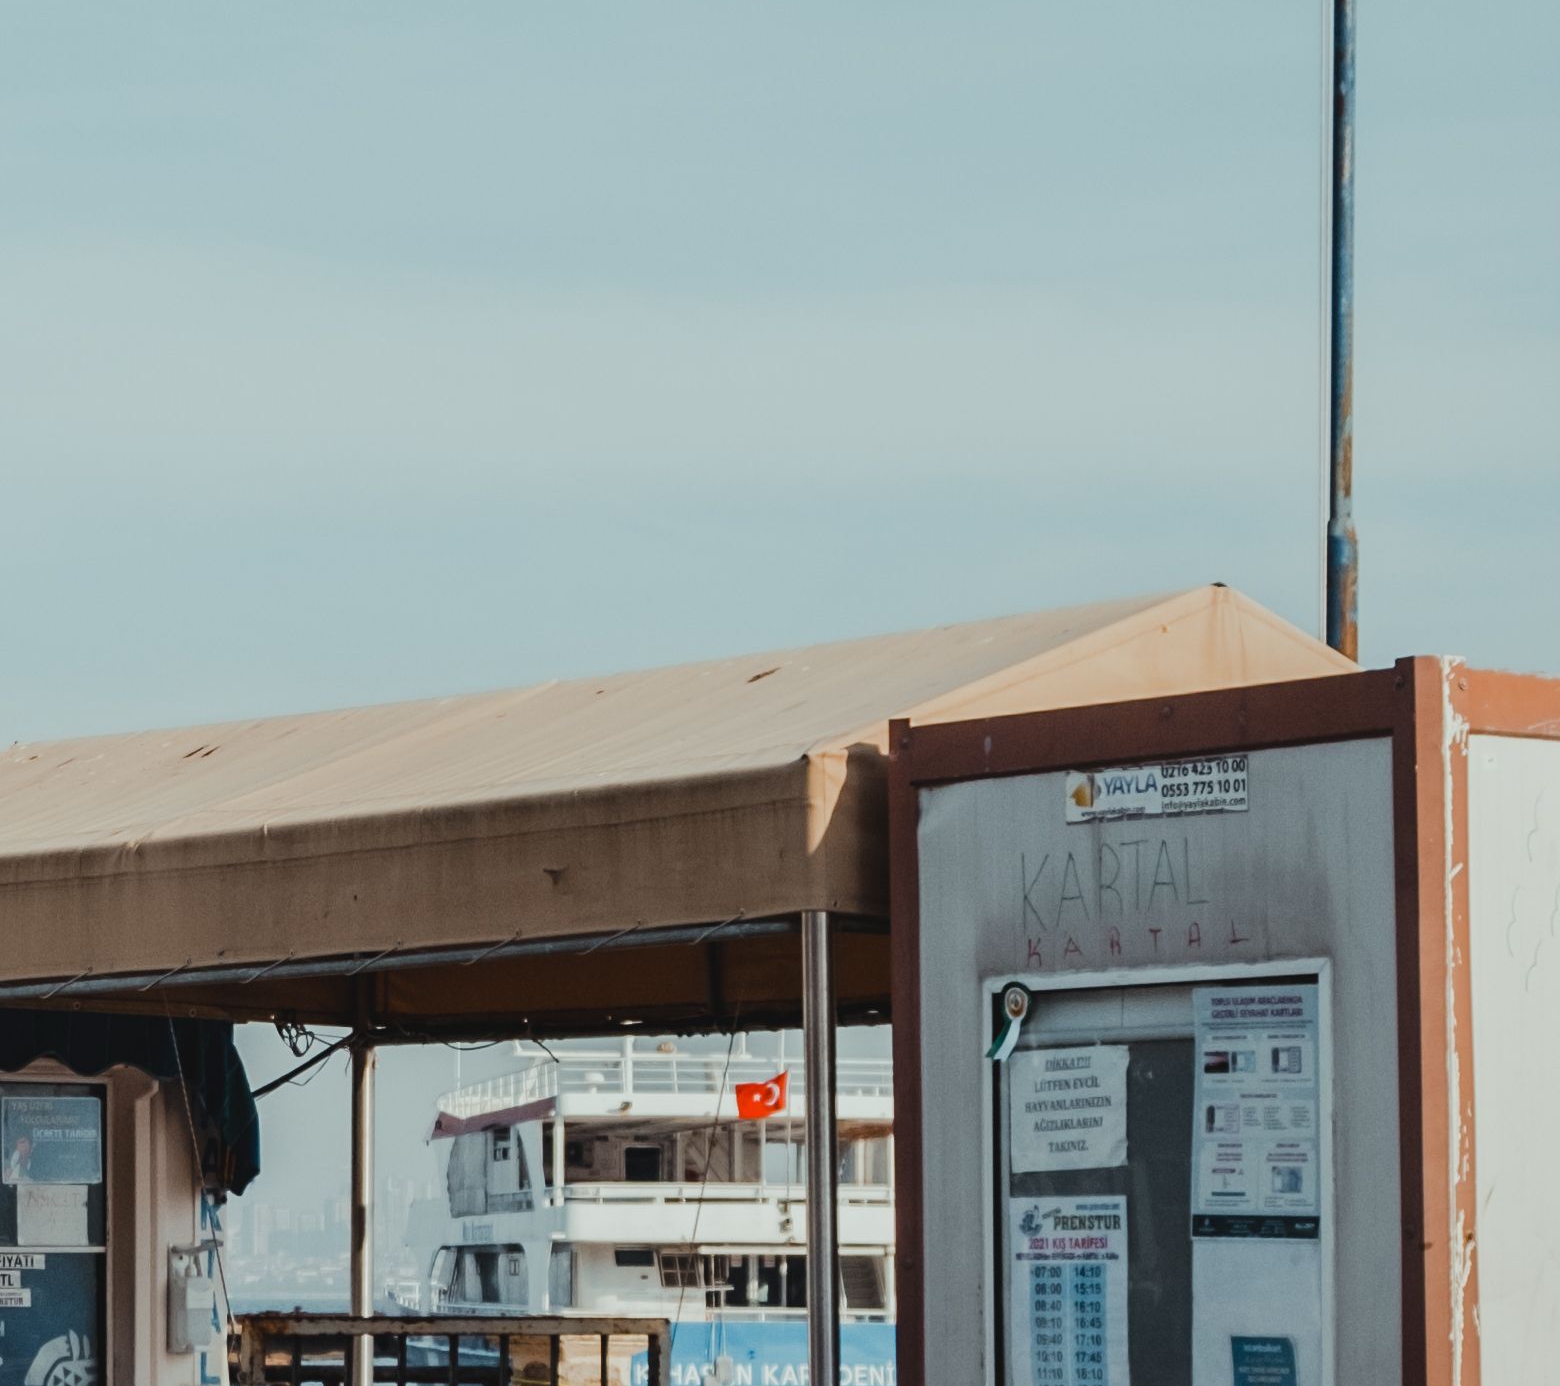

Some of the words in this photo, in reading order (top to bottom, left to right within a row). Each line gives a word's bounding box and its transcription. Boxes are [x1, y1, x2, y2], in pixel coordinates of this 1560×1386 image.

[1103, 773, 1157, 797] YAYLA
[1216, 760, 1230, 774] 10
[1231, 759, 1246, 772] 00
[1161, 782, 1189, 797] 0553
[1192, 781, 1214, 795] 775
[1218, 779, 1230, 794] 10
[1233, 778, 1246, 792] 01
[1021, 837, 1209, 937] KARTAL
[1028, 919, 1249, 967] KARTAL
[1054, 1214, 1121, 1230] PRENSTUR
[1029, 1237, 1049, 1250] 2021
[0, 1273, 14, 1287] TL
